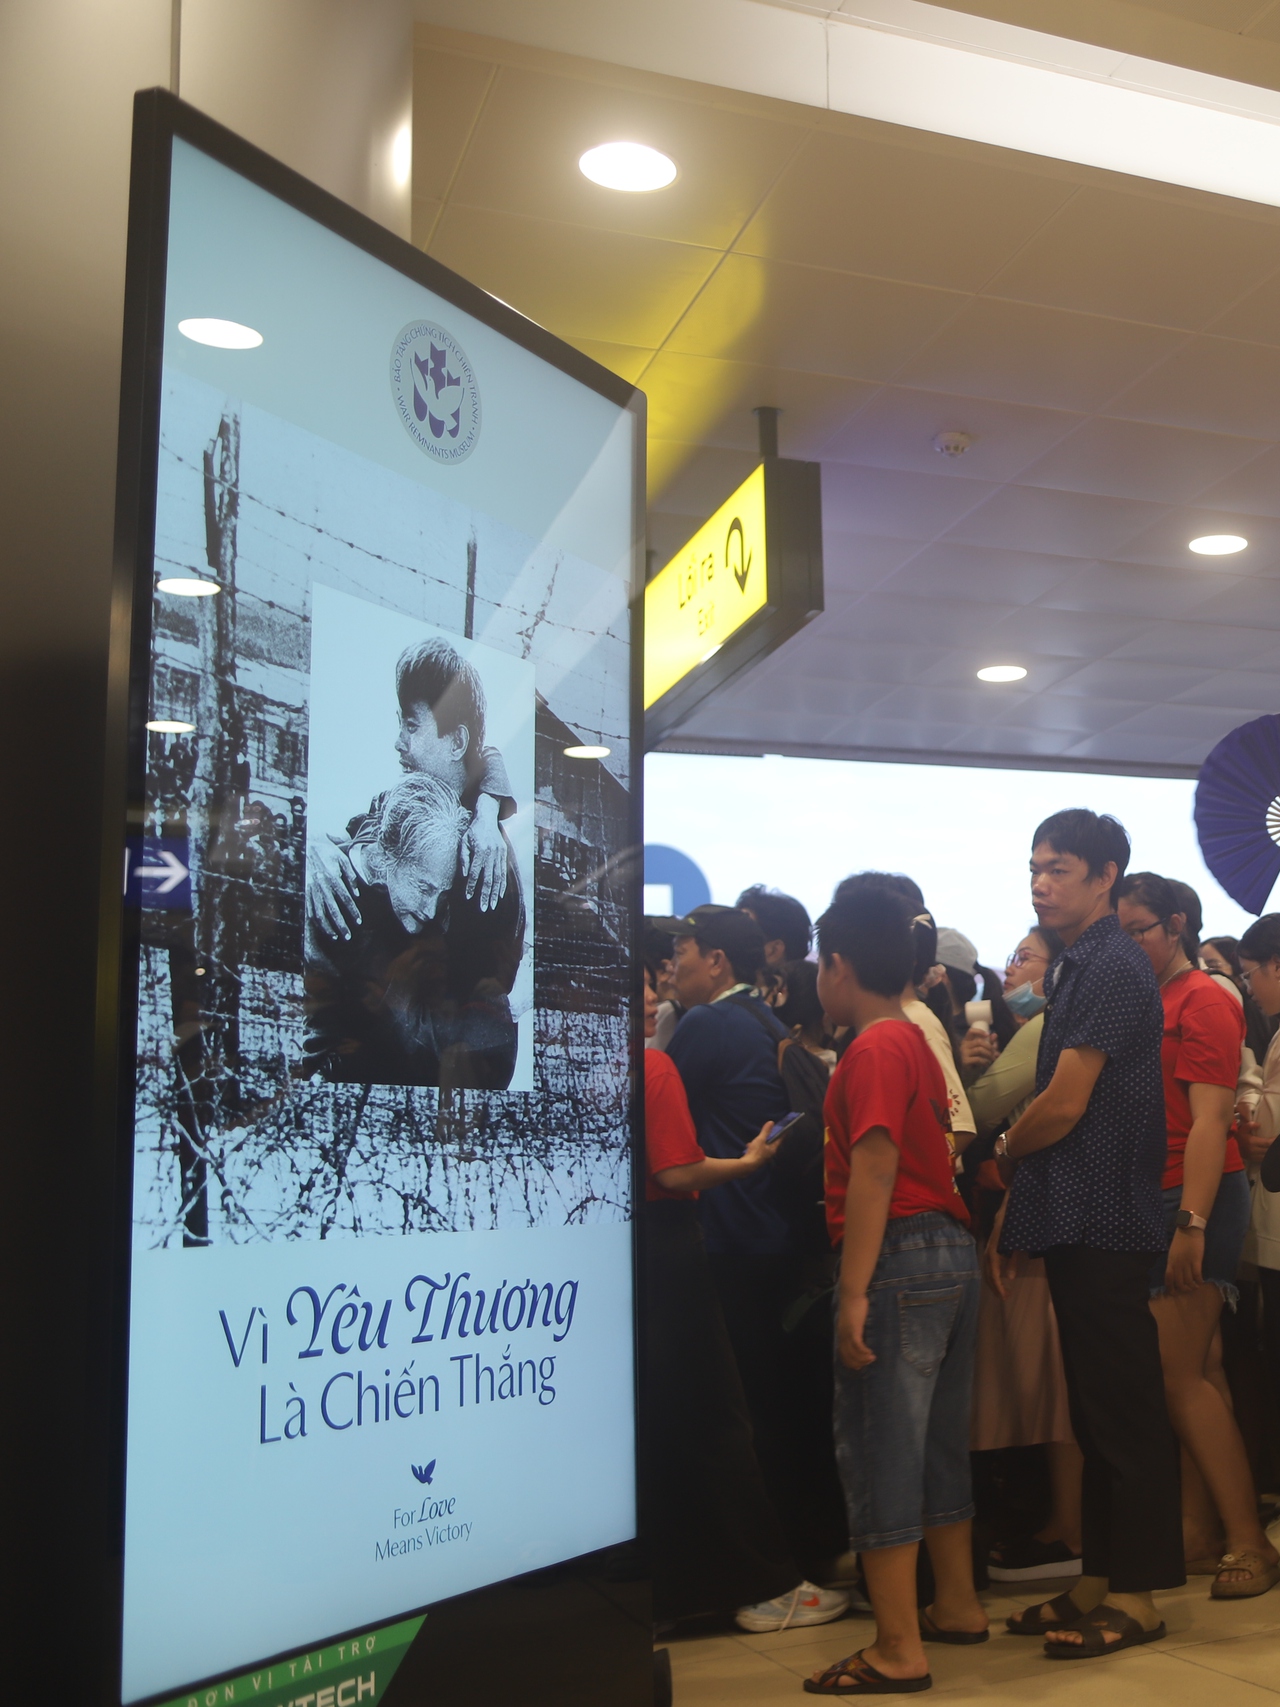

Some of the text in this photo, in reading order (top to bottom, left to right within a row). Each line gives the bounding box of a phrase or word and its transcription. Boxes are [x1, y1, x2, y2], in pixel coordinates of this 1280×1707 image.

[397, 395, 475, 459] WAR REMNANTS MUSEUM
[469, 386, 479, 424] TRANH
[219, 1272, 579, 1368] Vì Yêu Thương
[260, 1343, 556, 1444] Là Chiến Thắng
[393, 1496, 456, 1529] For Love
[375, 1521, 472, 1562] Means Victory
[187, 1635, 376, 1707] ĐƠN VỊ TÀI TRỢ
[278, 1670, 376, 1707] TECH
